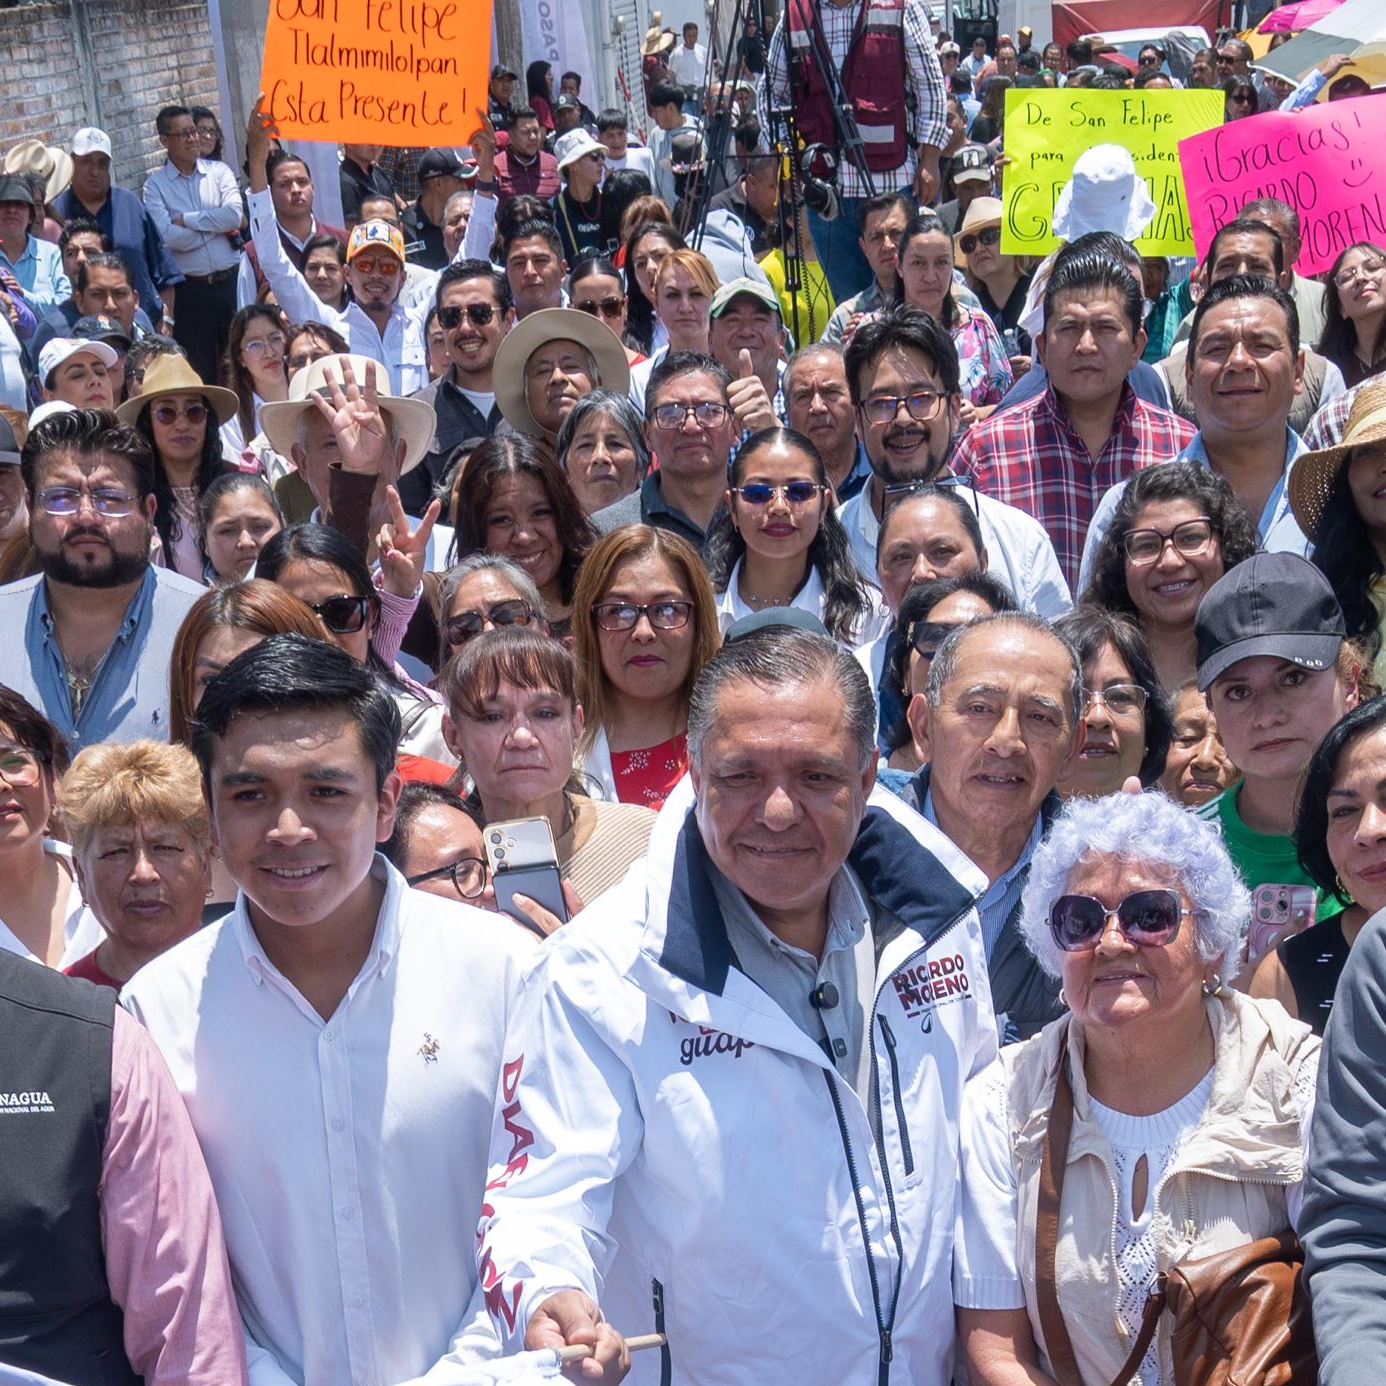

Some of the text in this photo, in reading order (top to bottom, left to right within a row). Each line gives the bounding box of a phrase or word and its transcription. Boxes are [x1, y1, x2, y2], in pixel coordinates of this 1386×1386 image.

[1027, 99, 1173, 131] De San Felipe
[1030, 151, 1065, 169] para
[892, 953, 964, 993] RICRDO
[898, 973, 969, 1012] MOENO
